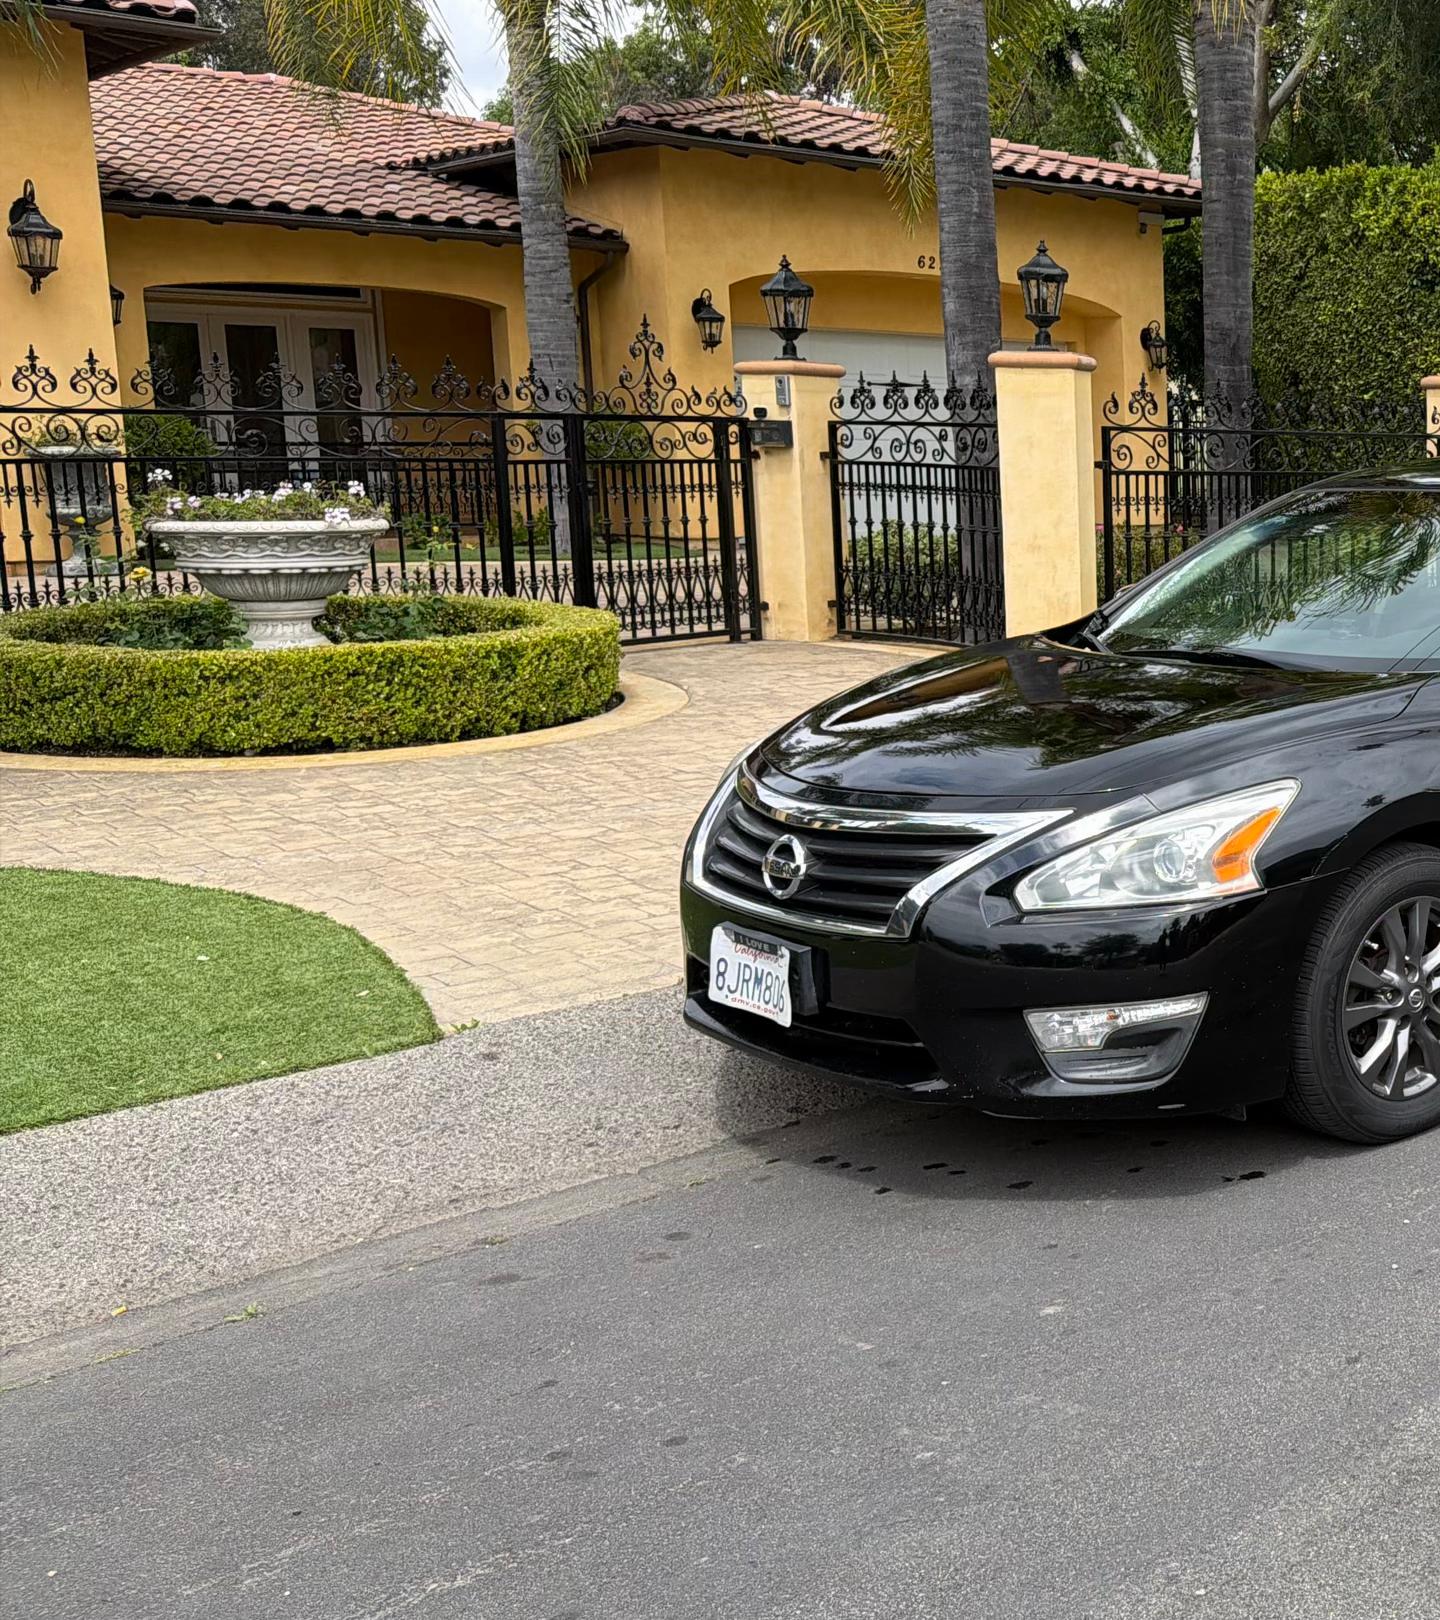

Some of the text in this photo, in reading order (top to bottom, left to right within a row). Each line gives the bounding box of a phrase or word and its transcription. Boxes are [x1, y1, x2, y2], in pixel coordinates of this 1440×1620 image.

[917, 255, 941, 270] 62
[745, 937, 770, 952] LOVE
[715, 957, 786, 1013] 8JRM806
